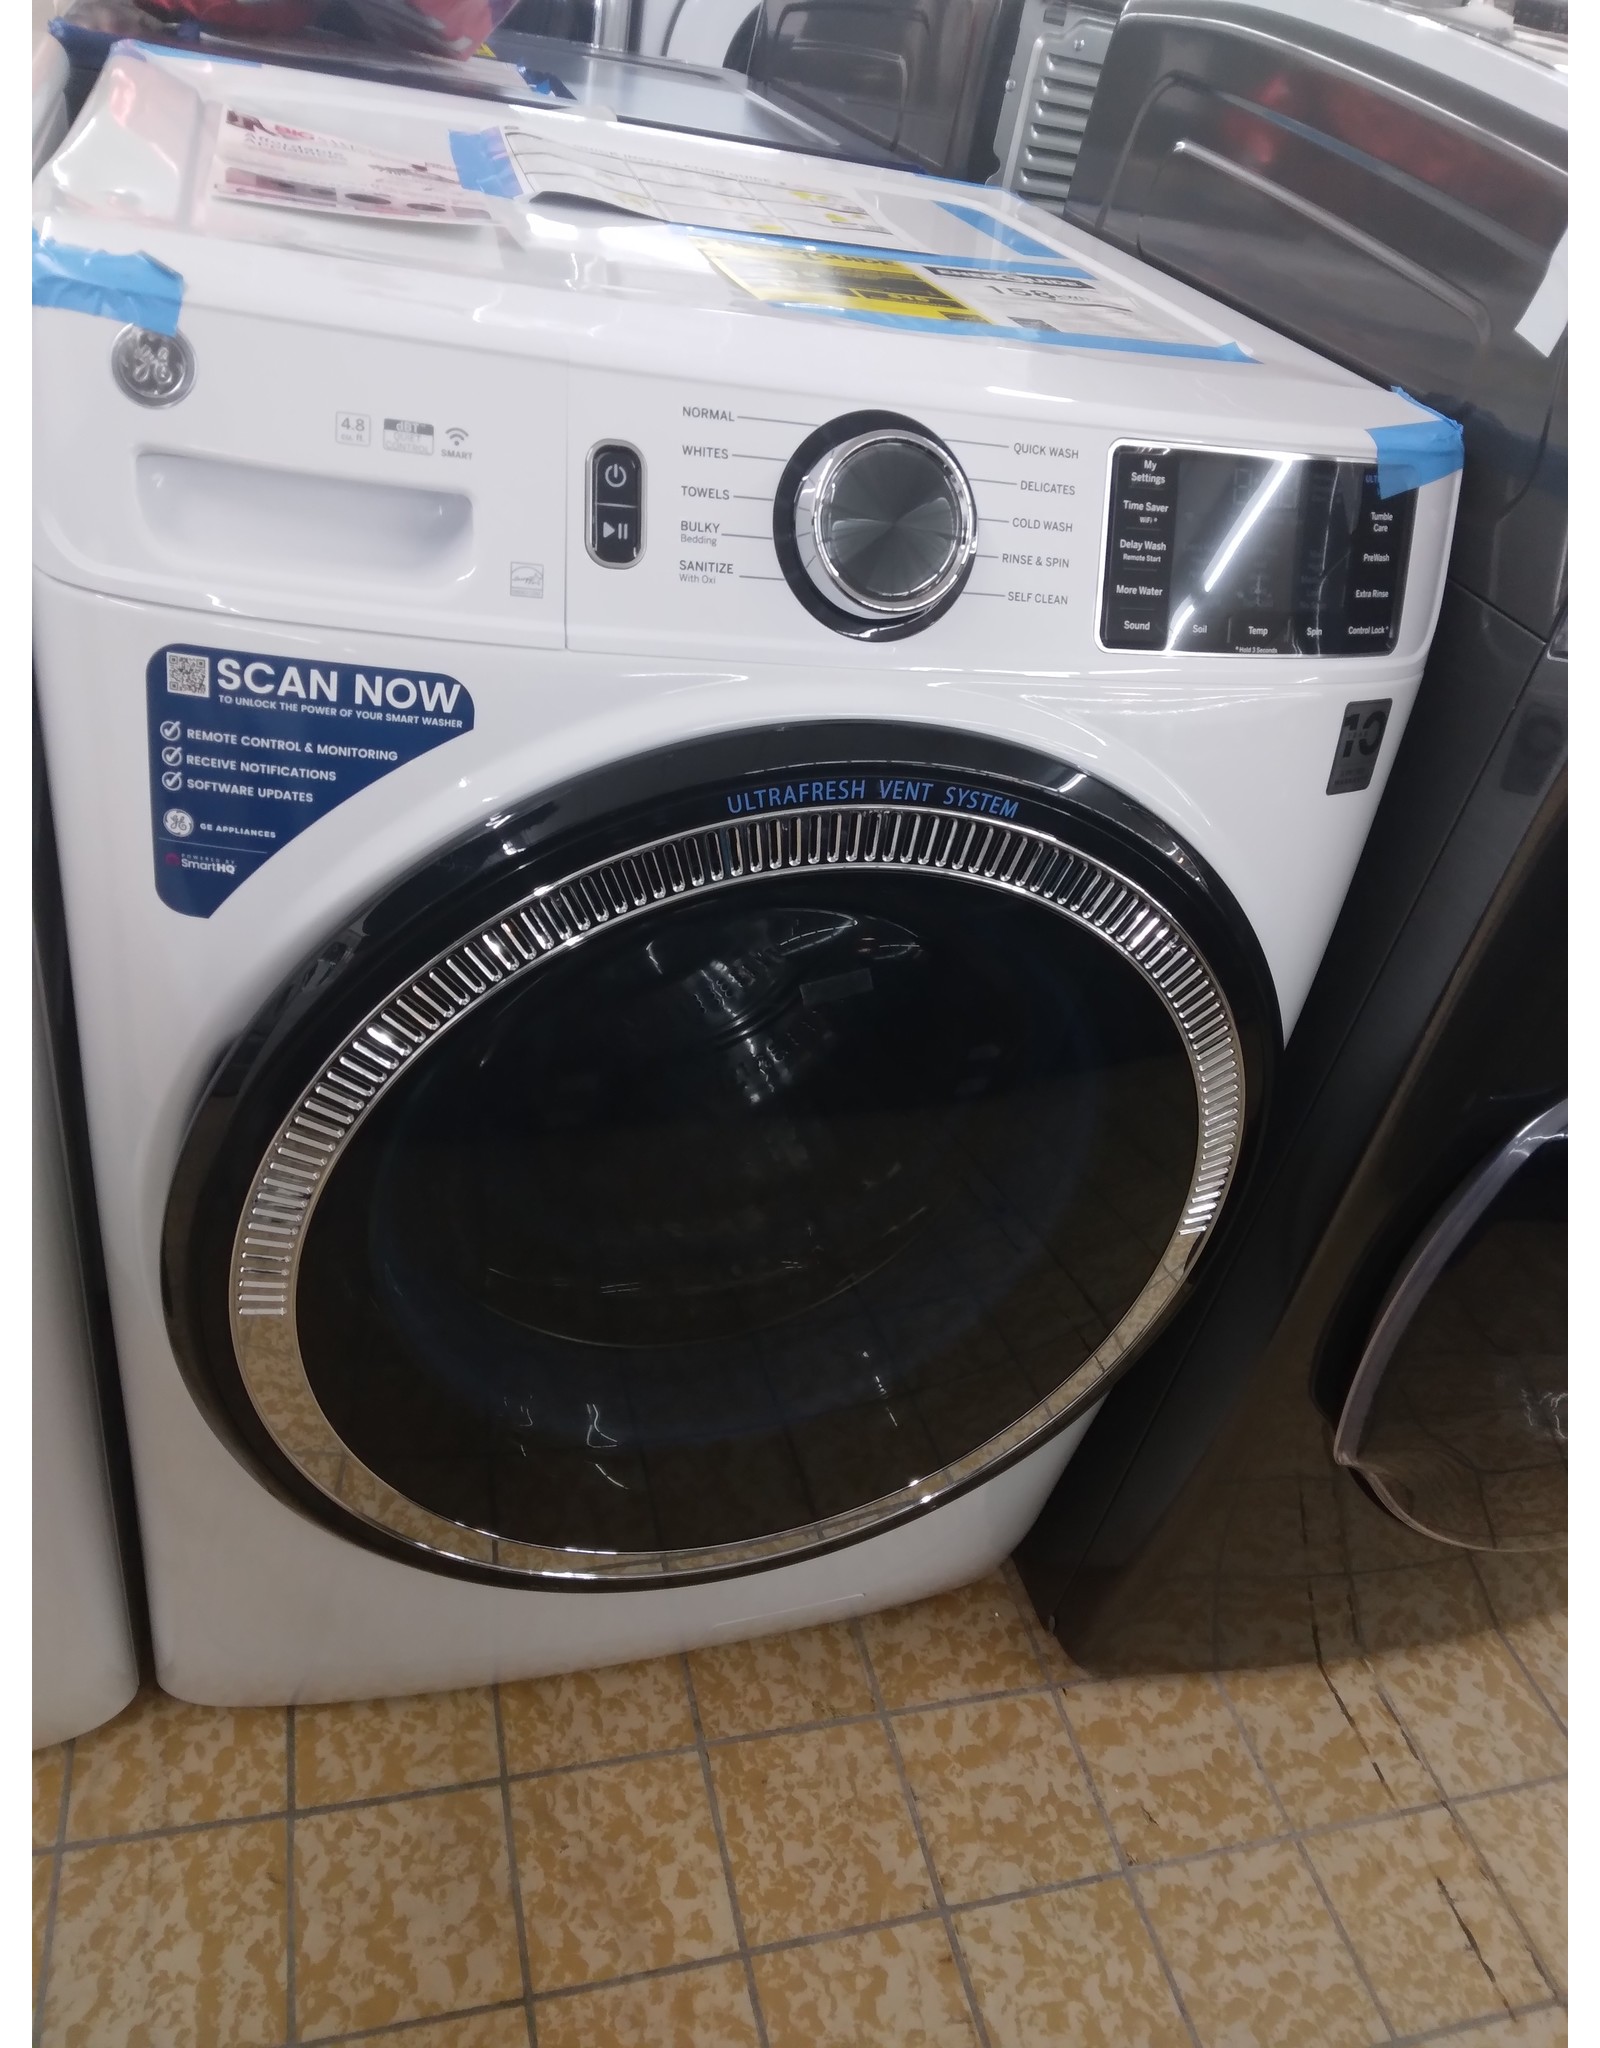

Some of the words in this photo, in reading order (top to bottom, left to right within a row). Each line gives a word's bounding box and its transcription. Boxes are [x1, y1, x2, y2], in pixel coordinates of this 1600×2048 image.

[682, 406, 735, 422] NORMAL
[340, 417, 365, 432] 4.8
[440, 448, 473, 460] SMART
[682, 445, 729, 460] WHITES
[1013, 442, 1046, 456] QUICK
[1049, 447, 1079, 459] WASH
[1143, 459, 1157, 472] My
[1131, 472, 1166, 485] Settings
[681, 485, 730, 500] TOWELS
[1020, 480, 1076, 496] DELICATES
[1123, 500, 1144, 511] Time
[1145, 501, 1169, 513] Saver
[1370, 511, 1393, 521] Tumble
[680, 520, 721, 533] BULKY
[1012, 517, 1041, 530] COLD
[1043, 520, 1073, 532] WASH
[1373, 523, 1388, 533] Care
[680, 534, 717, 547] Bedding
[1119, 539, 1142, 551] Delay
[1144, 540, 1167, 551] Wash
[1002, 553, 1033, 566] RINSE
[1035, 556, 1043, 566] &
[1045, 557, 1070, 568] SPIN
[1122, 553, 1145, 562] Remote
[1146, 554, 1161, 563] Start
[1363, 553, 1390, 563] PreWash
[679, 559, 734, 574] SANITIZE
[679, 573, 700, 584] With
[702, 574, 716, 585] Oxi
[1116, 584, 1137, 595] More
[1138, 585, 1163, 596] Water
[1355, 589, 1371, 598] Extra
[1372, 589, 1389, 598] Rinse
[1007, 591, 1032, 603] SELF
[1034, 593, 1068, 605] CLEAN
[1123, 620, 1150, 631] Sound
[1192, 624, 1208, 634] Soil
[1248, 626, 1268, 637] Temp
[1306, 626, 1323, 637] Spin
[1348, 626, 1370, 635] Control
[1371, 626, 1385, 635] Lock
[216, 657, 338, 702] SCAN
[354, 673, 461, 714] NOW
[218, 694, 233, 705] TO
[235, 696, 277, 710] UNLOCK
[279, 701, 298, 713] THE
[300, 704, 337, 718] POWER
[339, 708, 353, 718] OF
[355, 710, 383, 722] YOUR
[385, 712, 419, 725] SMART
[422, 716, 463, 729] WASHER
[1342, 710, 1387, 758] 10
[187, 728, 238, 745] REMOTE
[240, 734, 301, 753] CONTROL
[304, 742, 314, 753] &
[316, 743, 398, 761] MONITORING
[186, 754, 237, 771] RECEIVE
[240, 760, 337, 781] NOTIFICATIONS
[186, 778, 254, 797] SOFTWARE
[257, 787, 314, 803] UPDATES
[726, 779, 866, 815] ULTRAFRESH
[879, 779, 934, 802] VENT
[943, 786, 1020, 819] SYSTEM
[199, 823, 213, 831] GE
[215, 825, 276, 838] APPLIANCES
[181, 853, 220, 864] POWERED
[181, 858, 236, 875] SmartHQ
